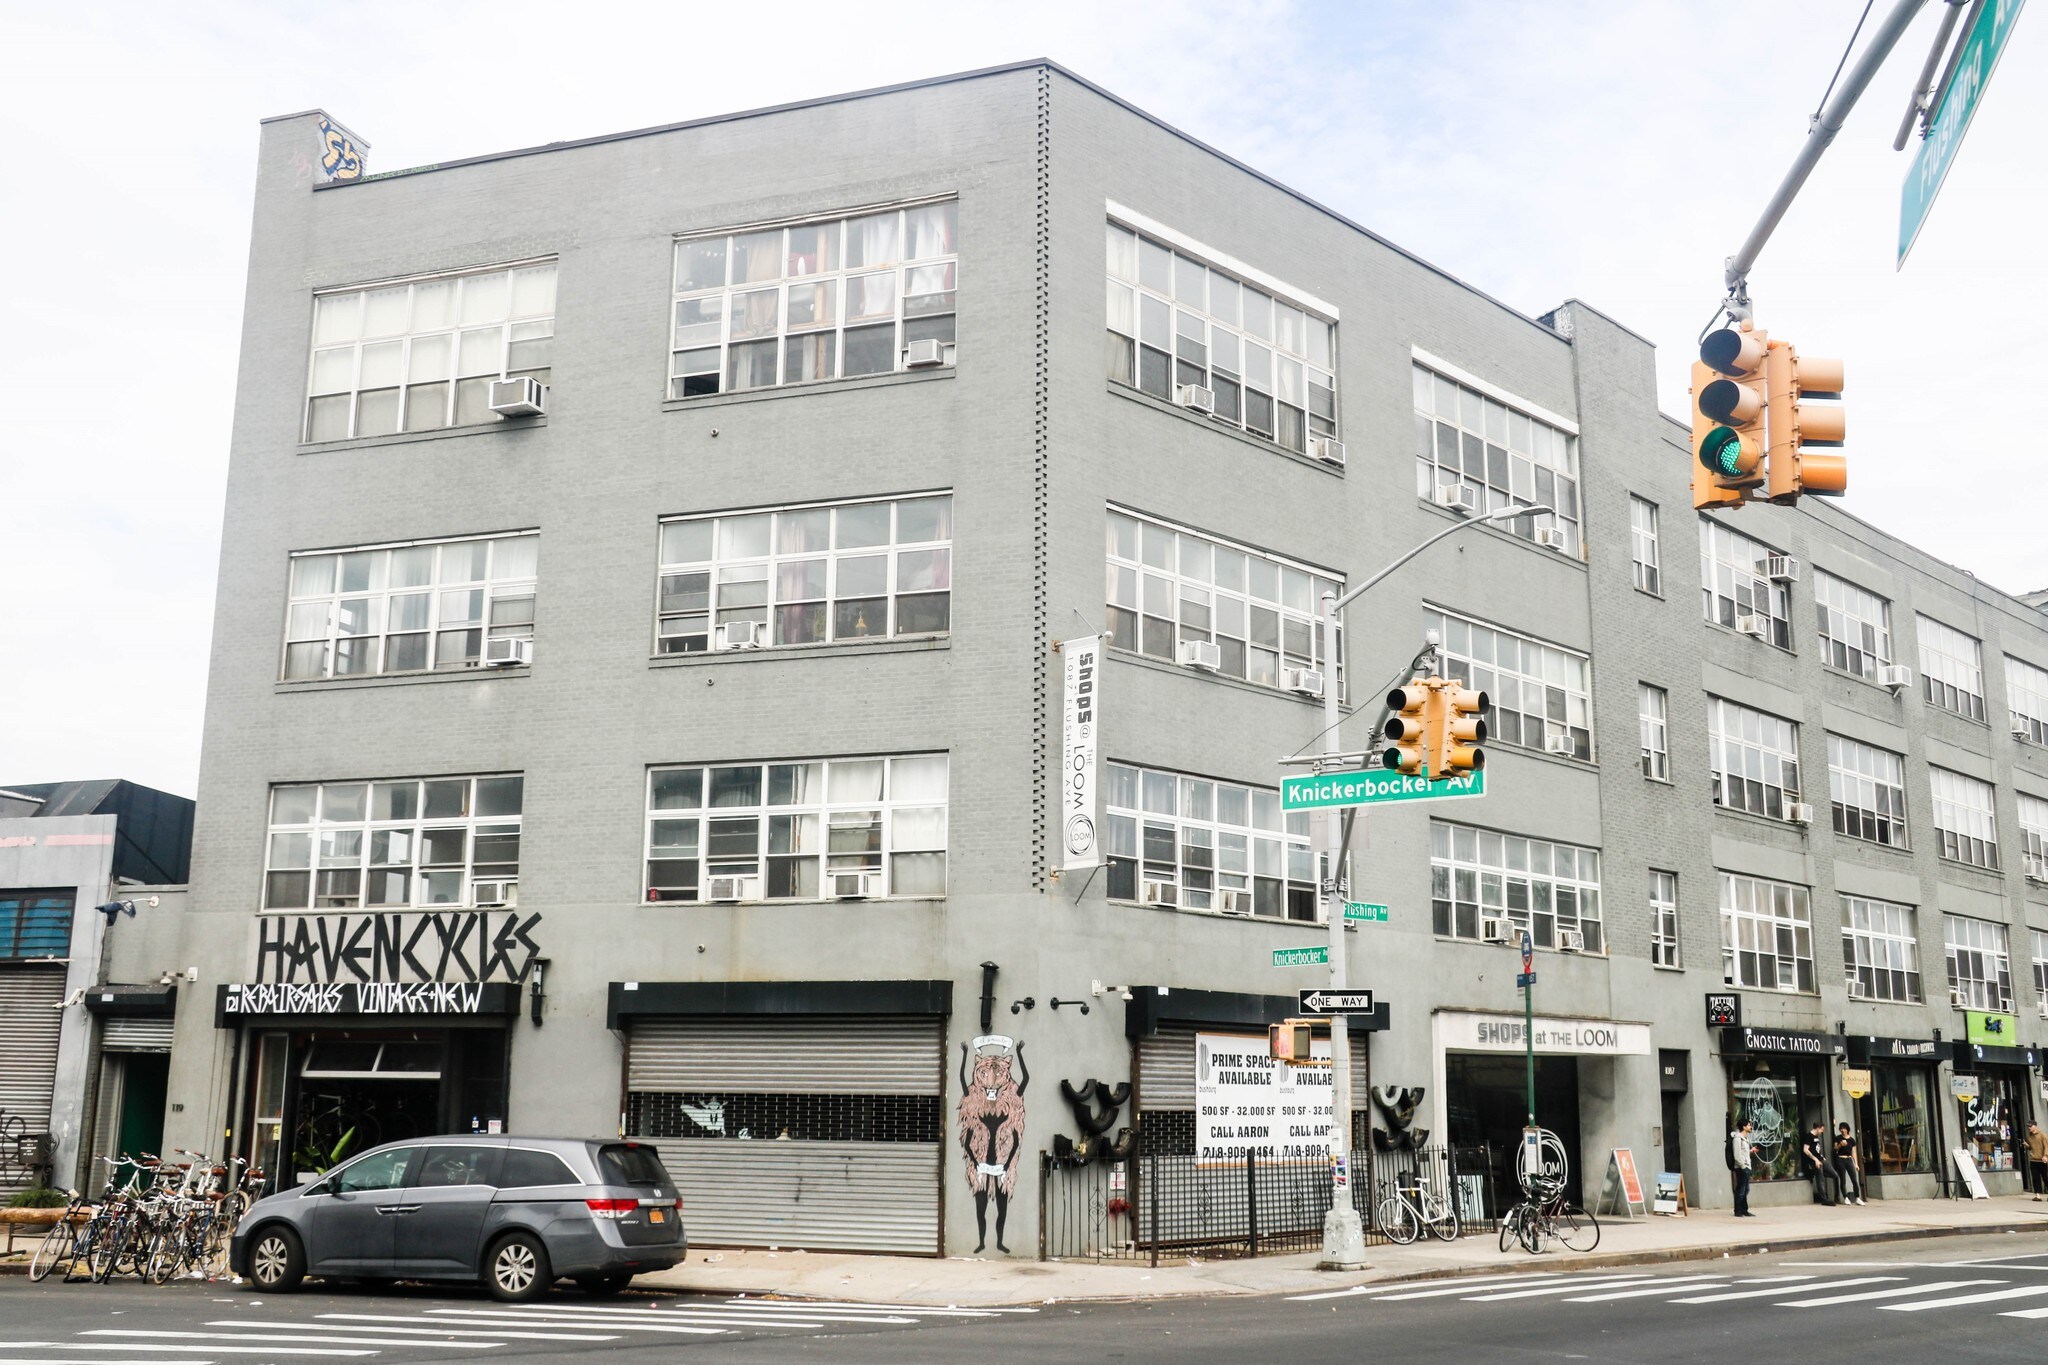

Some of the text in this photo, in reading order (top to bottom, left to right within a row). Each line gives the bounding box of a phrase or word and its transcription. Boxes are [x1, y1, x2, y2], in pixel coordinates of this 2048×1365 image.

[1920, 39, 1983, 202] Flushing
[1066, 656, 1074, 690] 1087
[1085, 749, 1093, 766] THE
[1073, 745, 1085, 809] LOOM
[1289, 774, 1476, 803] Knickerbocker Av
[1344, 904, 1387, 920] Flushing Av
[1274, 949, 1321, 966] Knickerbocker
[1310, 997, 1364, 1007] ONE WAY
[1709, 996, 1735, 1010] TATTOO
[1535, 1030, 1547, 1045] at
[1550, 1031, 1572, 1046] THE
[1575, 1029, 1618, 1048] LOOM
[1746, 1034, 1821, 1052] GNOSTIC TATTOO
[1212, 1053, 1243, 1068] PRIME
[1218, 1071, 1272, 1085] AVAILABLE
[1296, 1073, 1332, 1085] AVAILAB
[1202, 1106, 1218, 1116] 500
[1220, 1106, 1229, 1115] SF
[1267, 1106, 1276, 1115] SF
[1282, 1106, 1295, 1115] 500
[1297, 1106, 1306, 1115] SF
[1967, 1096, 1999, 1128] Sent!
[1210, 1126, 1269, 1138] CALL AARON
[1289, 1125, 1332, 1137] CALL AAR
[1203, 1146, 1274, 1159] 718-9090464
[1539, 1161, 1560, 1176] OOM
